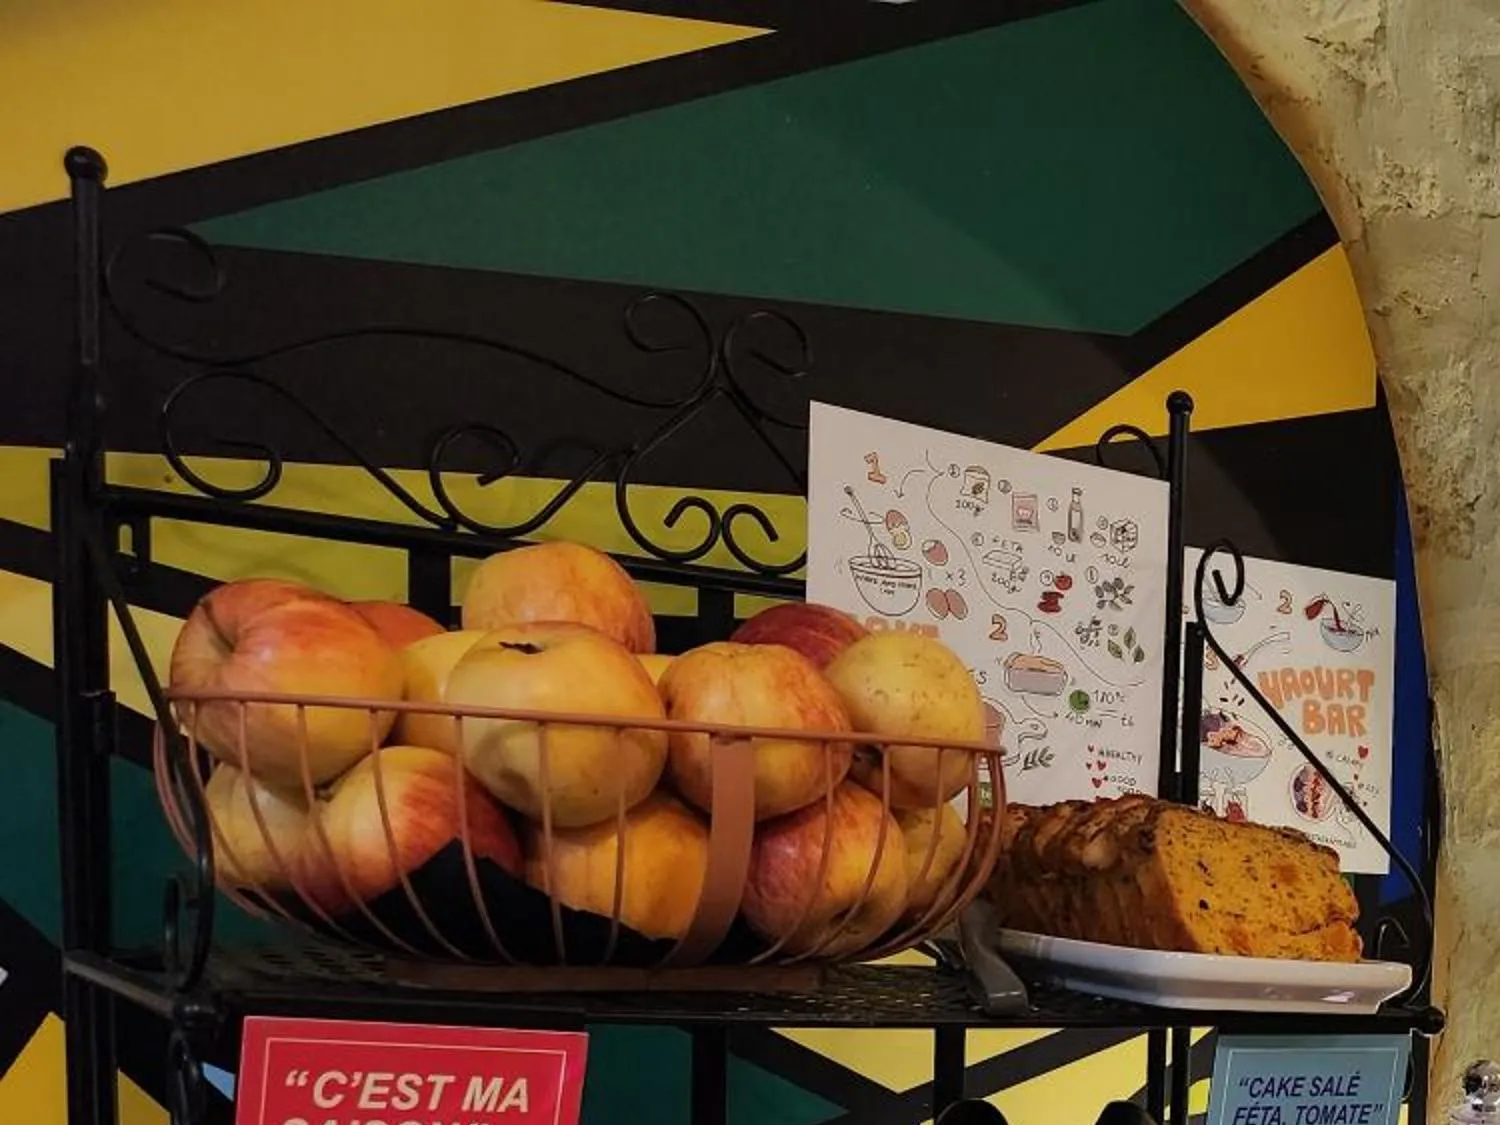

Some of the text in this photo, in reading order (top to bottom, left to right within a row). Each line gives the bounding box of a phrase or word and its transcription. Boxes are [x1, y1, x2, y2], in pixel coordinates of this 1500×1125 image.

[988, 613, 1008, 641] 2
[1257, 666, 1376, 710] YAOURT
[1302, 699, 1367, 738] BAR
[461, 1077, 530, 1114] MA
[1309, 1071, 1361, 1098] SALÉ
